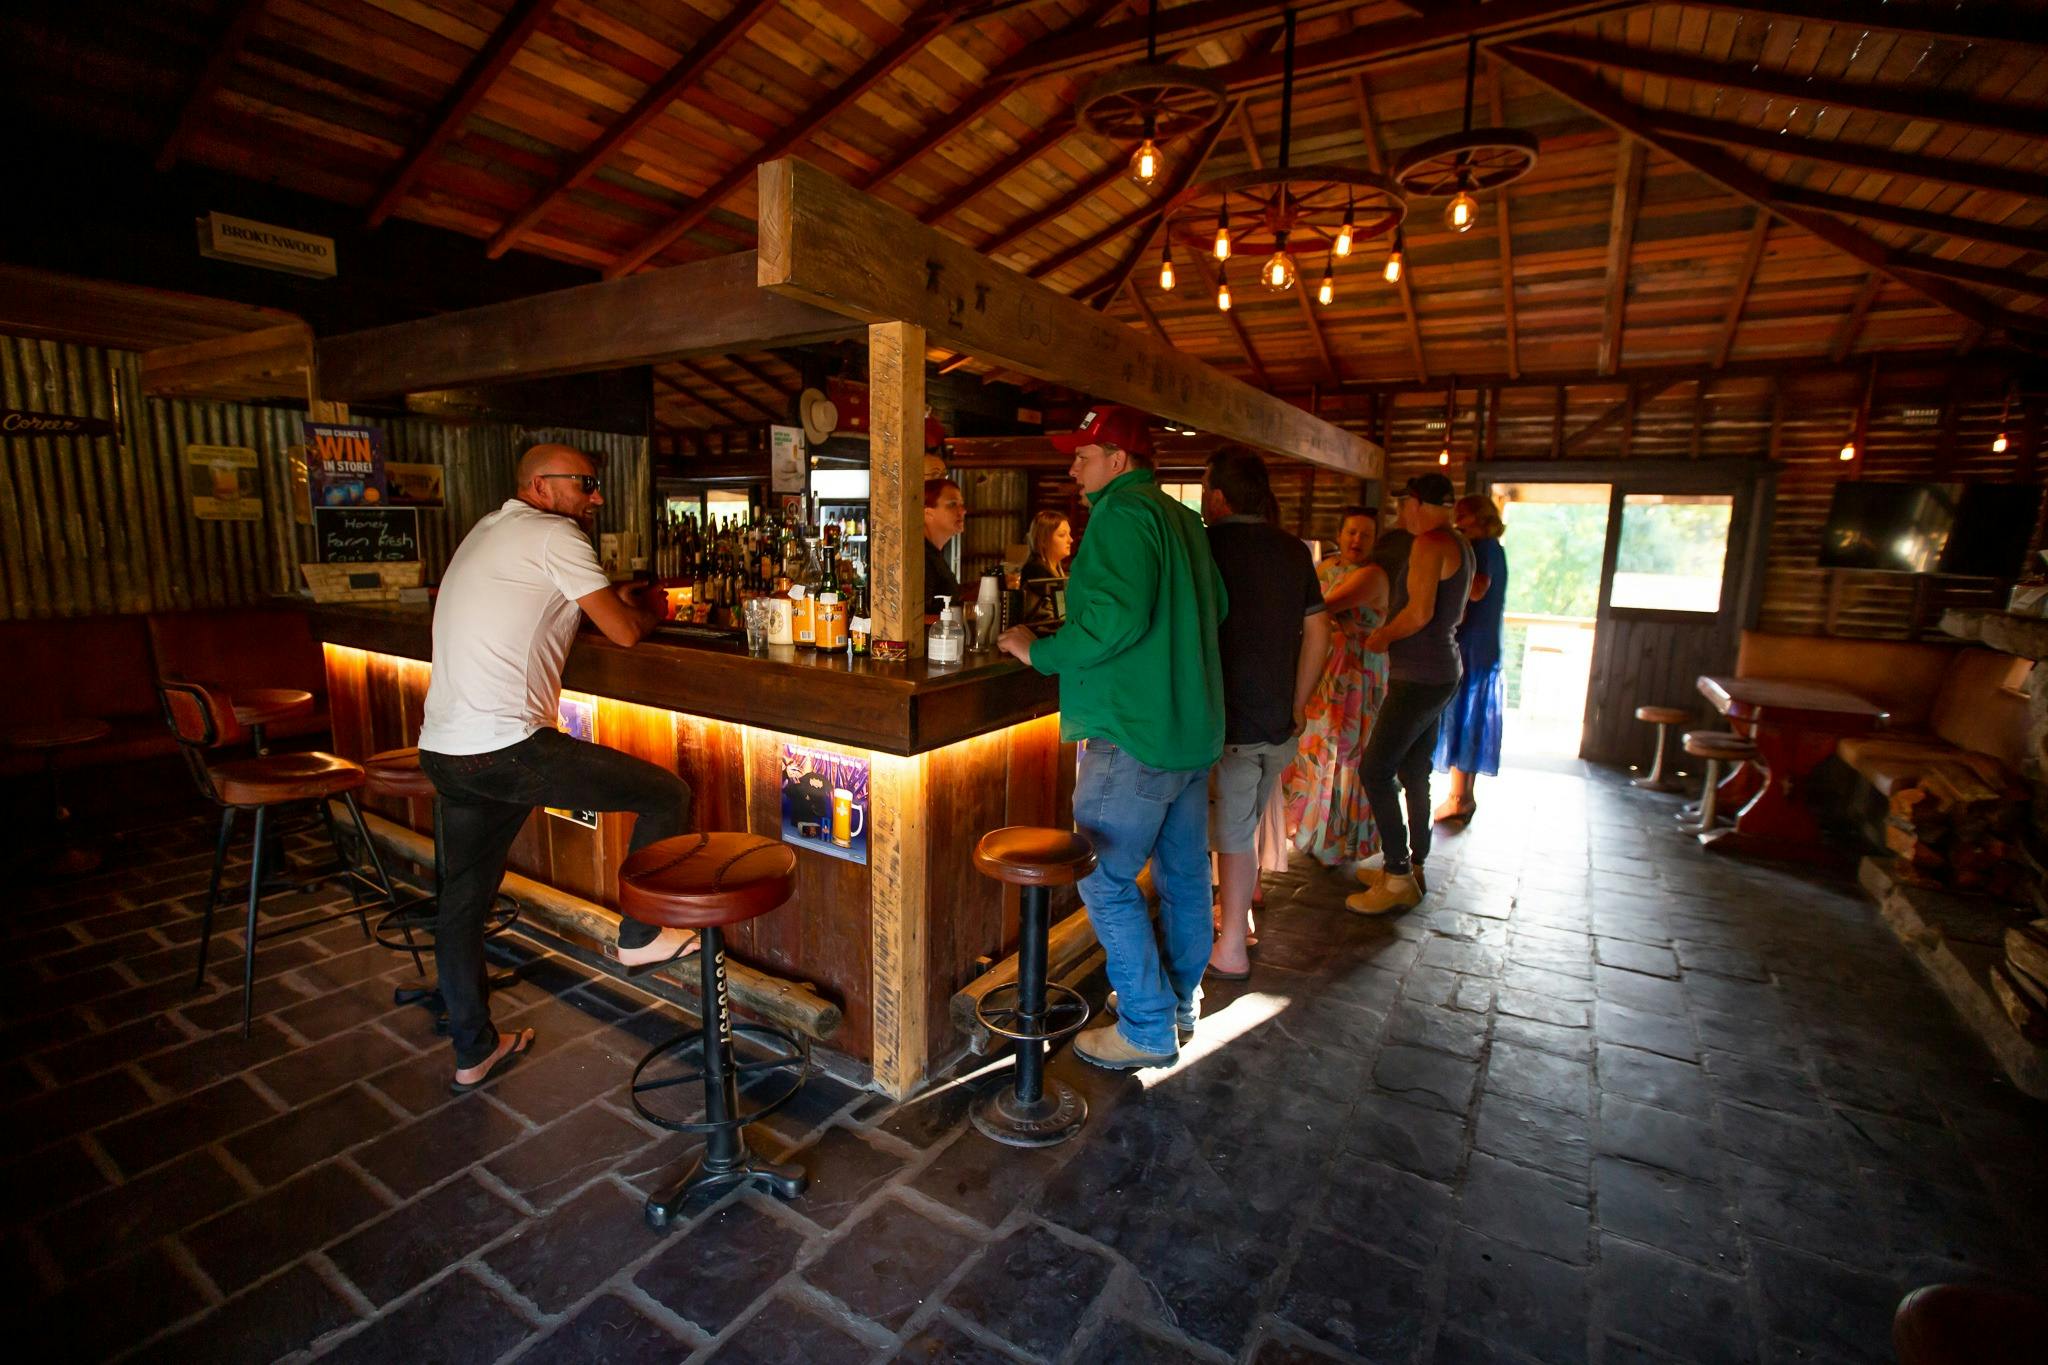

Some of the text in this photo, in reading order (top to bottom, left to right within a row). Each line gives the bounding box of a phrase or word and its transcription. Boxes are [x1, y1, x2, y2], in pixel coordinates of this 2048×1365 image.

[221, 223, 328, 257] BROKENWOOD
[2, 413, 80, 432] Corner
[334, 429, 360, 439] CHANCE
[315, 435, 372, 463] WIN
[323, 460, 373, 473] IN STORE!
